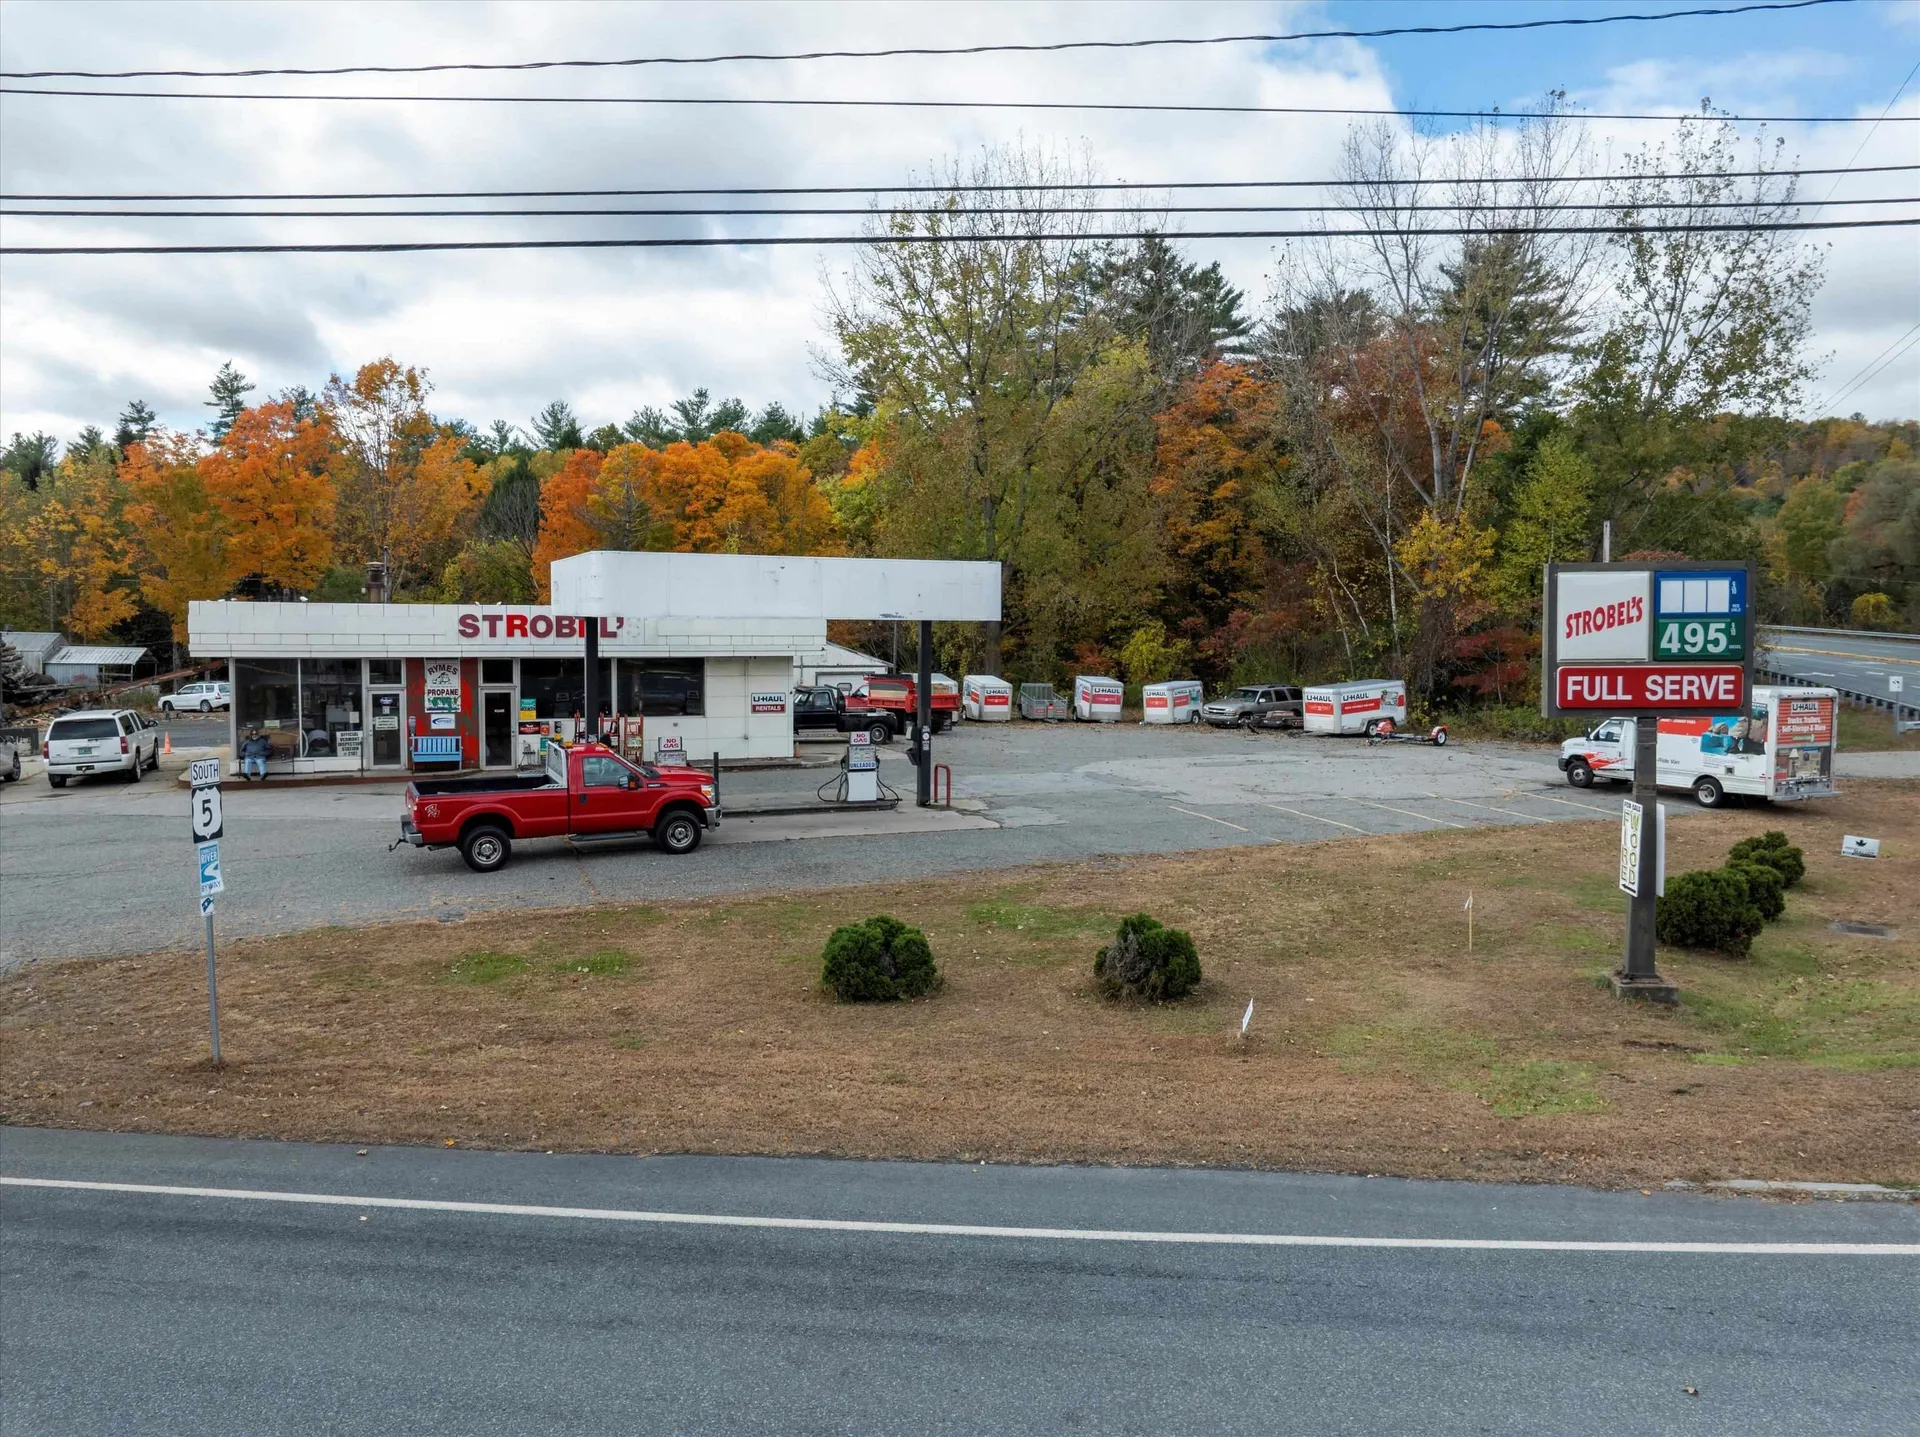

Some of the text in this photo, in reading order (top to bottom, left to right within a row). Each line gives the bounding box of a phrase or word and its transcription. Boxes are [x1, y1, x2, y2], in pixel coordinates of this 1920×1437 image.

[1565, 596, 1643, 639] STROBEL'S
[1660, 622, 1727, 654] 495
[427, 664, 458, 675] RYMES
[1567, 675, 1735, 700] FULL SERVE
[193, 764, 218, 780] SOUTH
[202, 798, 212, 828] 5
[201, 851, 217, 864] RIVER
